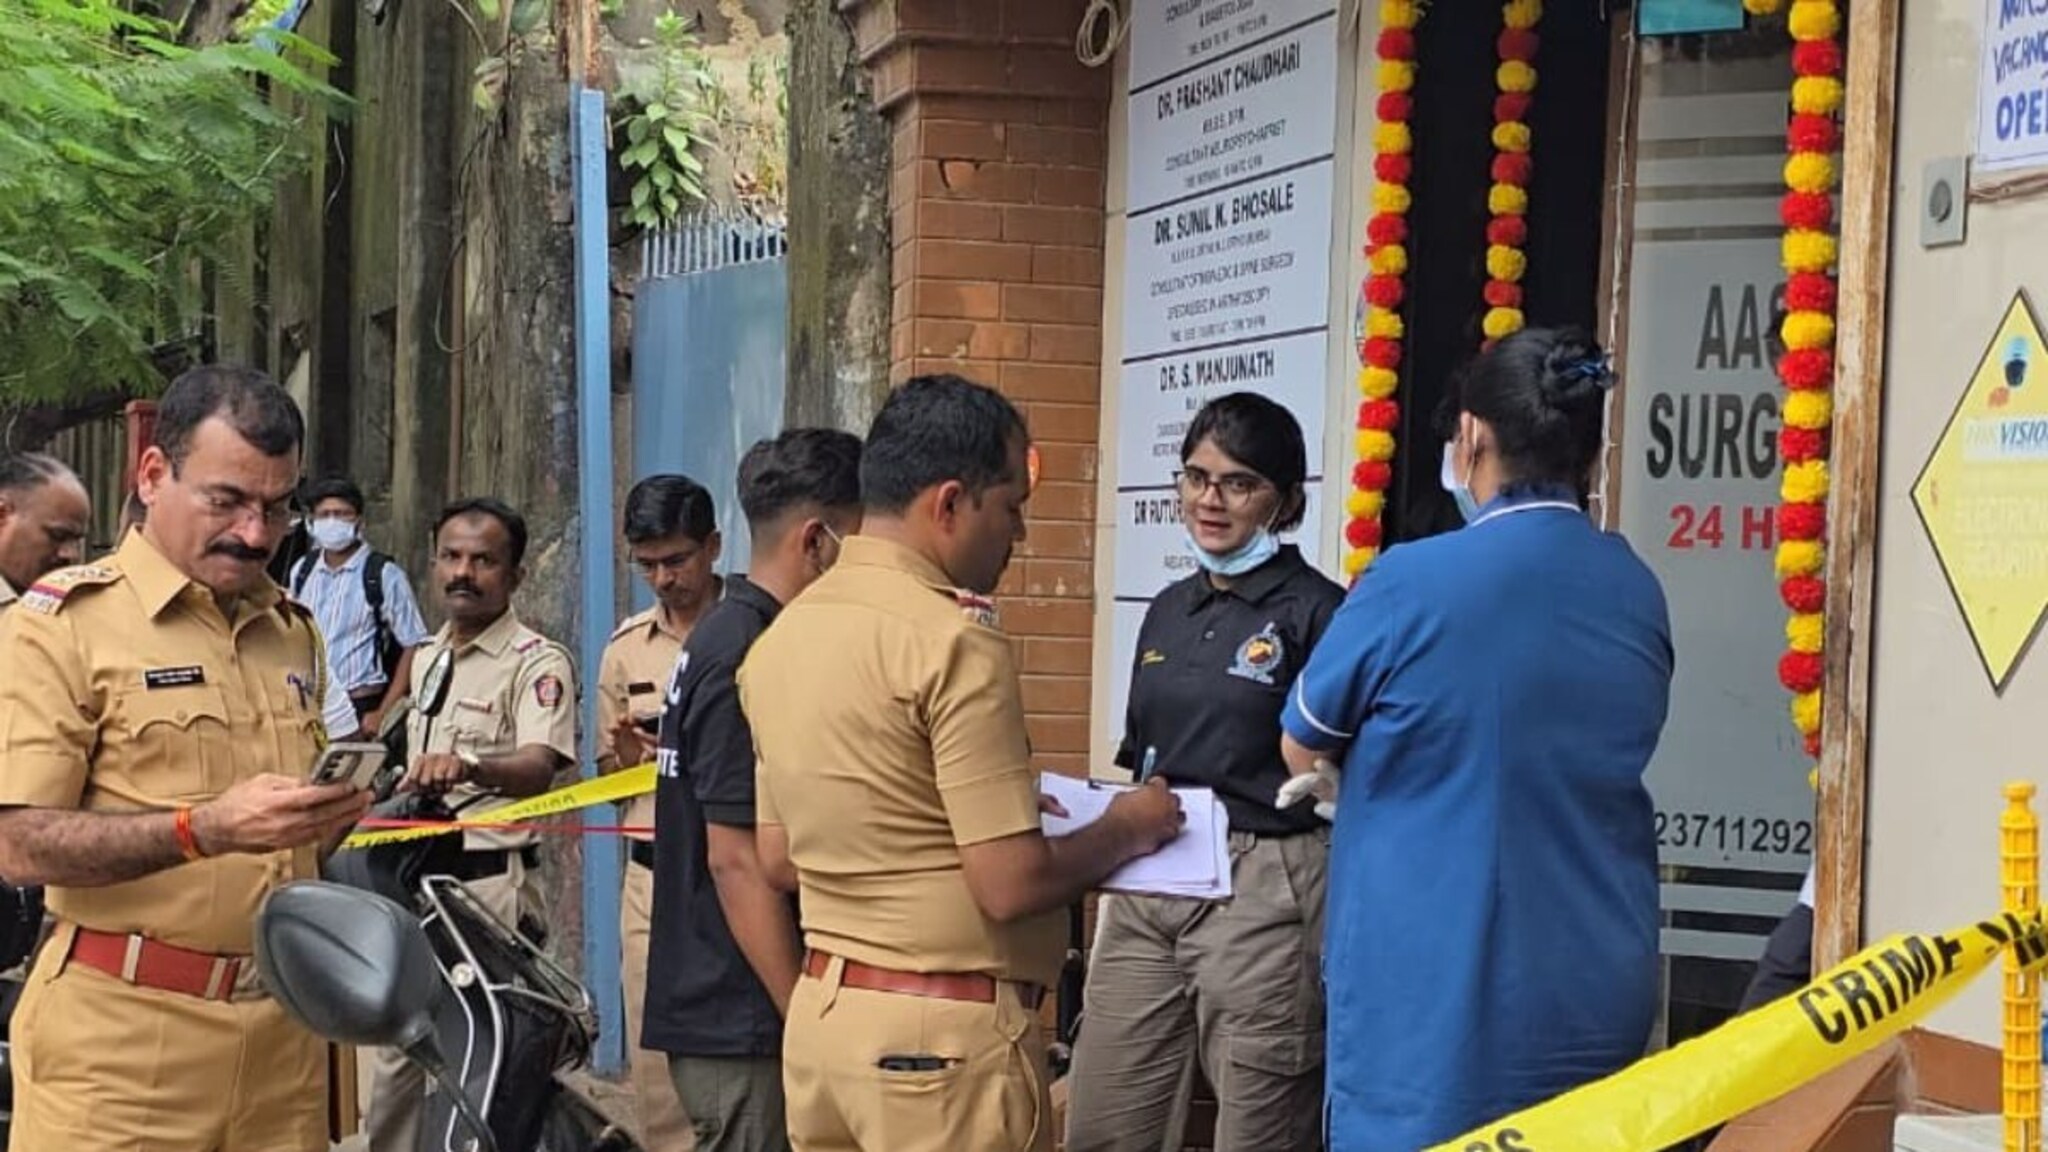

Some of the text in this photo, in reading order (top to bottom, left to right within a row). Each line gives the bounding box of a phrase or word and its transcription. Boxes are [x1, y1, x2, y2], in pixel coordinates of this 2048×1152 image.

[1157, 41, 1300, 120] DR. PRASHANT CHAUDHARI
[1996, 89, 2048, 140] OPE
[1155, 217, 1172, 246] DR.
[1177, 207, 1212, 239] SUNIL
[1232, 183, 1294, 225] BHOSALE
[1160, 350, 1275, 392] DR. S. MANJUNATH
[1646, 392, 1778, 480] SURG
[1667, 504, 1725, 550] 24
[1655, 811, 1813, 855] 23711292
[1797, 936, 1963, 1045] CRIME
